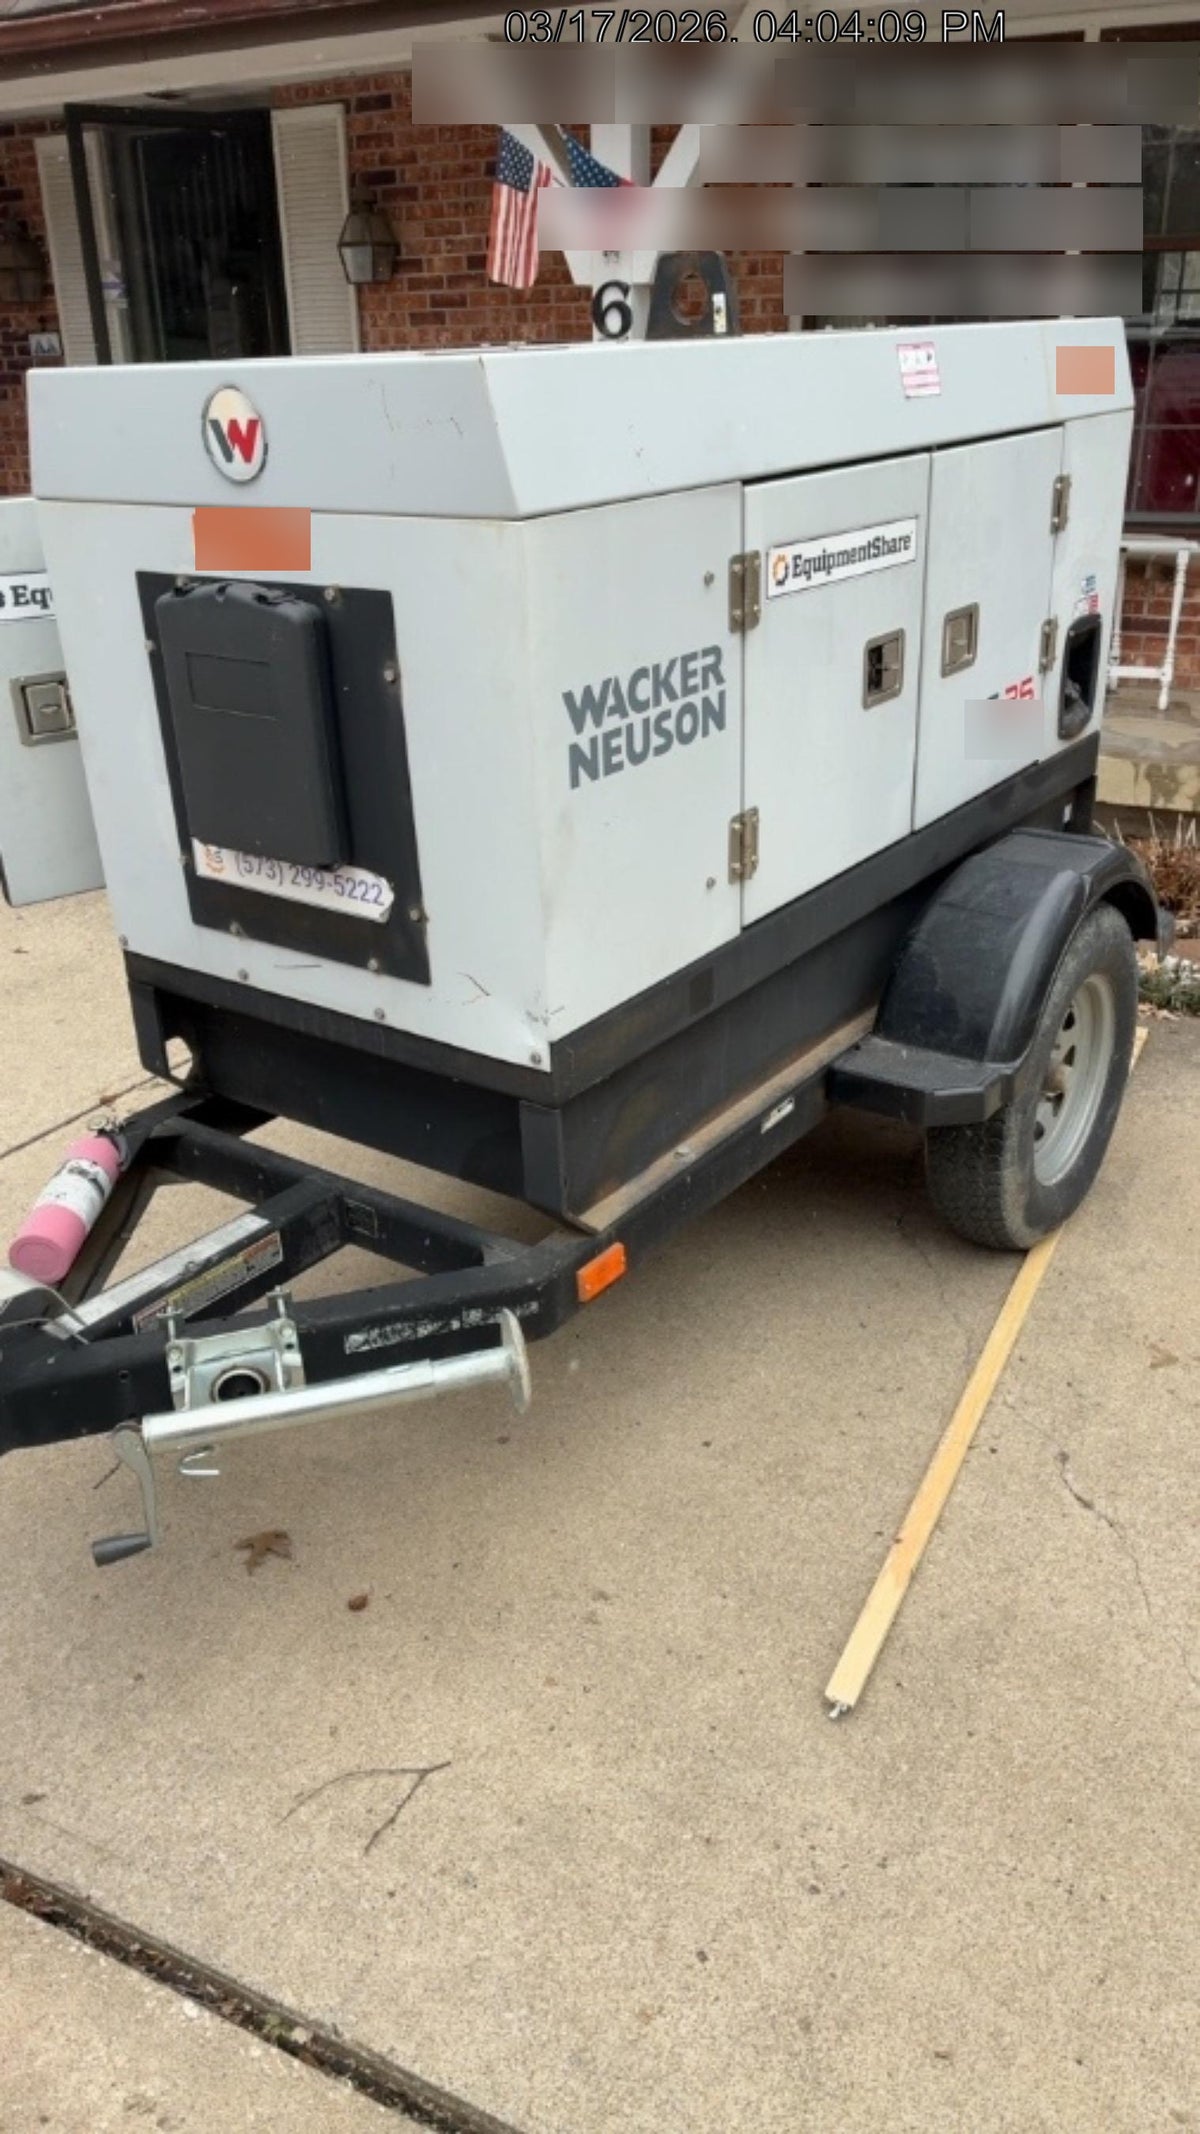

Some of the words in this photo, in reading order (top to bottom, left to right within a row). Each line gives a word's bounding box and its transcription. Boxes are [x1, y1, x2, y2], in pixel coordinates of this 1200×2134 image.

[593, 280, 632, 338] 6
[792, 534, 911, 581] EquipmentShare
[562, 644, 726, 735] WACKER
[569, 689, 726, 789] NEUSON
[235, 852, 283, 887] (573)
[289, 864, 385, 906] 299-5222
